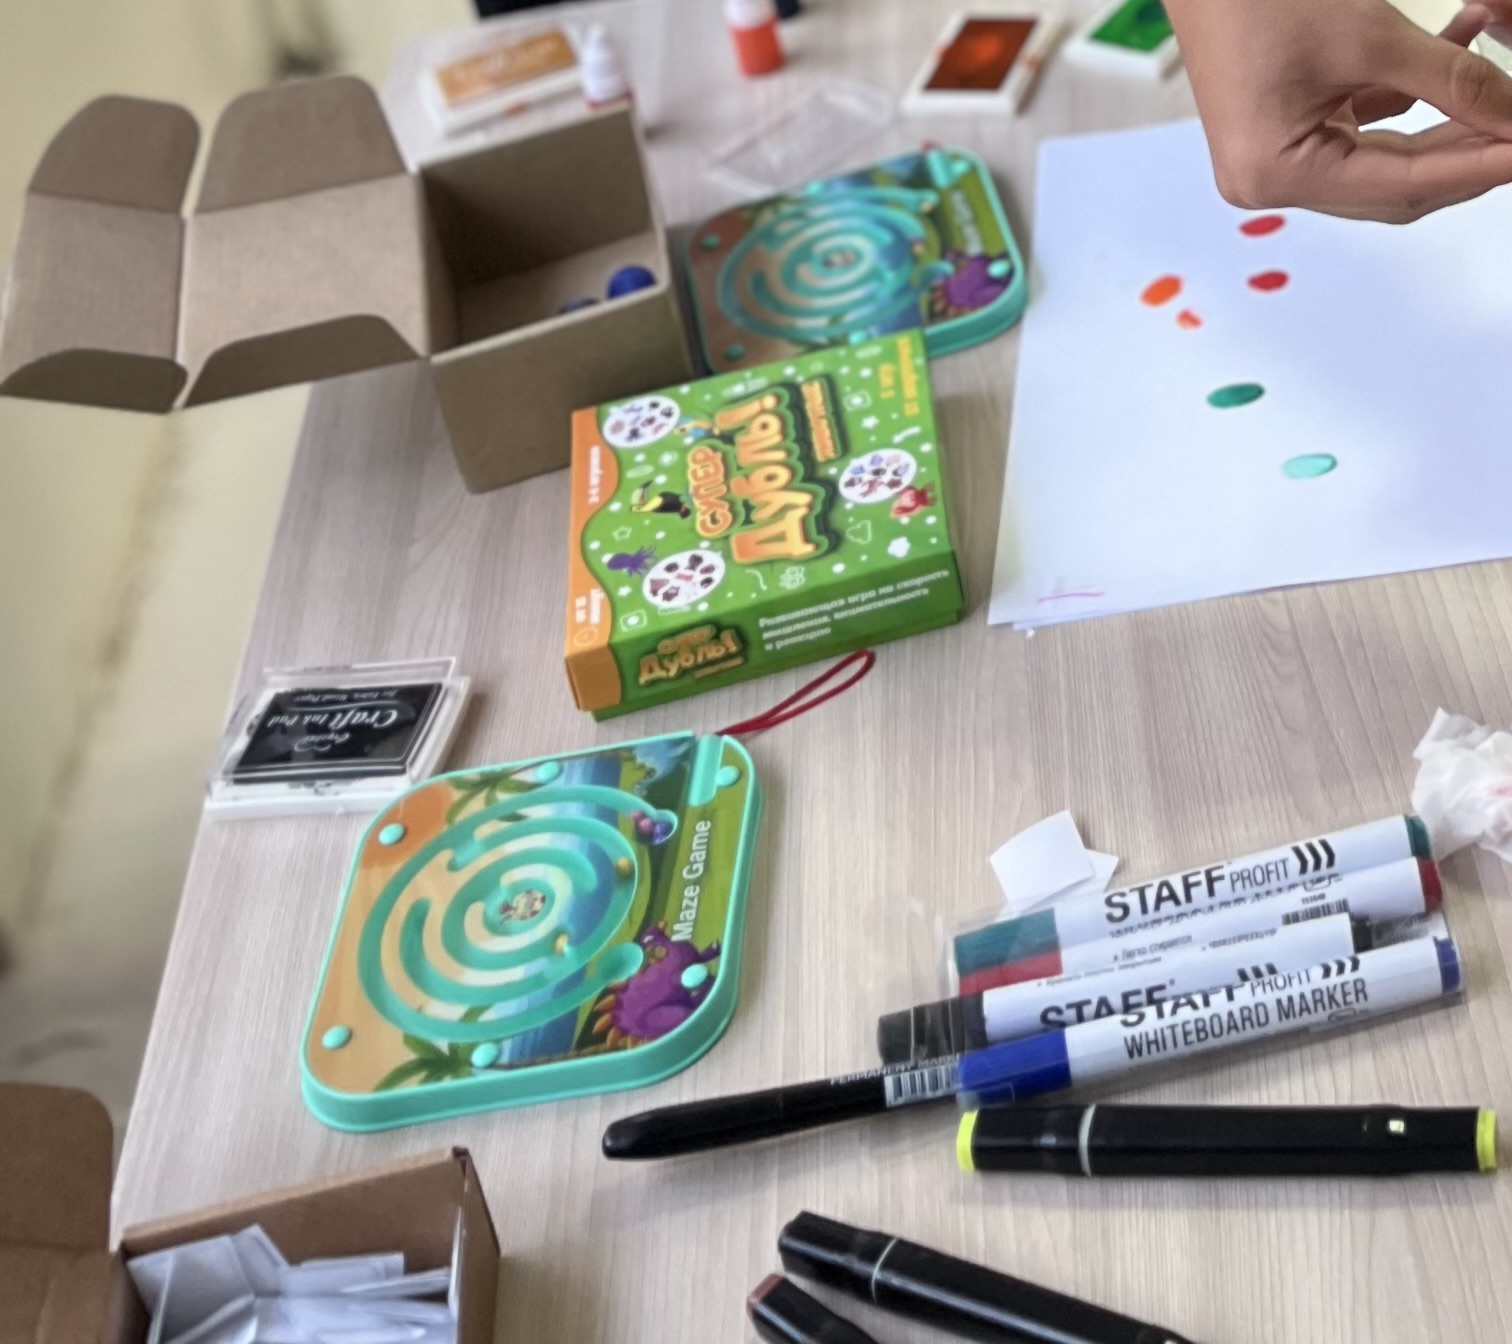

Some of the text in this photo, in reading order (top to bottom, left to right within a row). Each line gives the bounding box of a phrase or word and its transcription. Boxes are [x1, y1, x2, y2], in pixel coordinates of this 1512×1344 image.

[687, 445, 733, 537] СУПЕР
[714, 394, 816, 564] Дубль!
[759, 569, 949, 628] Развивающая игра на скорость
[834, 588, 929, 620] внимательность
[266, 708, 398, 730] Craft Ink Pad
[670, 820, 711, 942] Maze Game
[1104, 864, 1226, 924] STAFF
[1229, 857, 1290, 893] PROFIT
[1121, 942, 1148, 962] Легко
[1148, 935, 1193, 953] стирается
[1124, 977, 1368, 1060] WHITEBOARD MARKER
